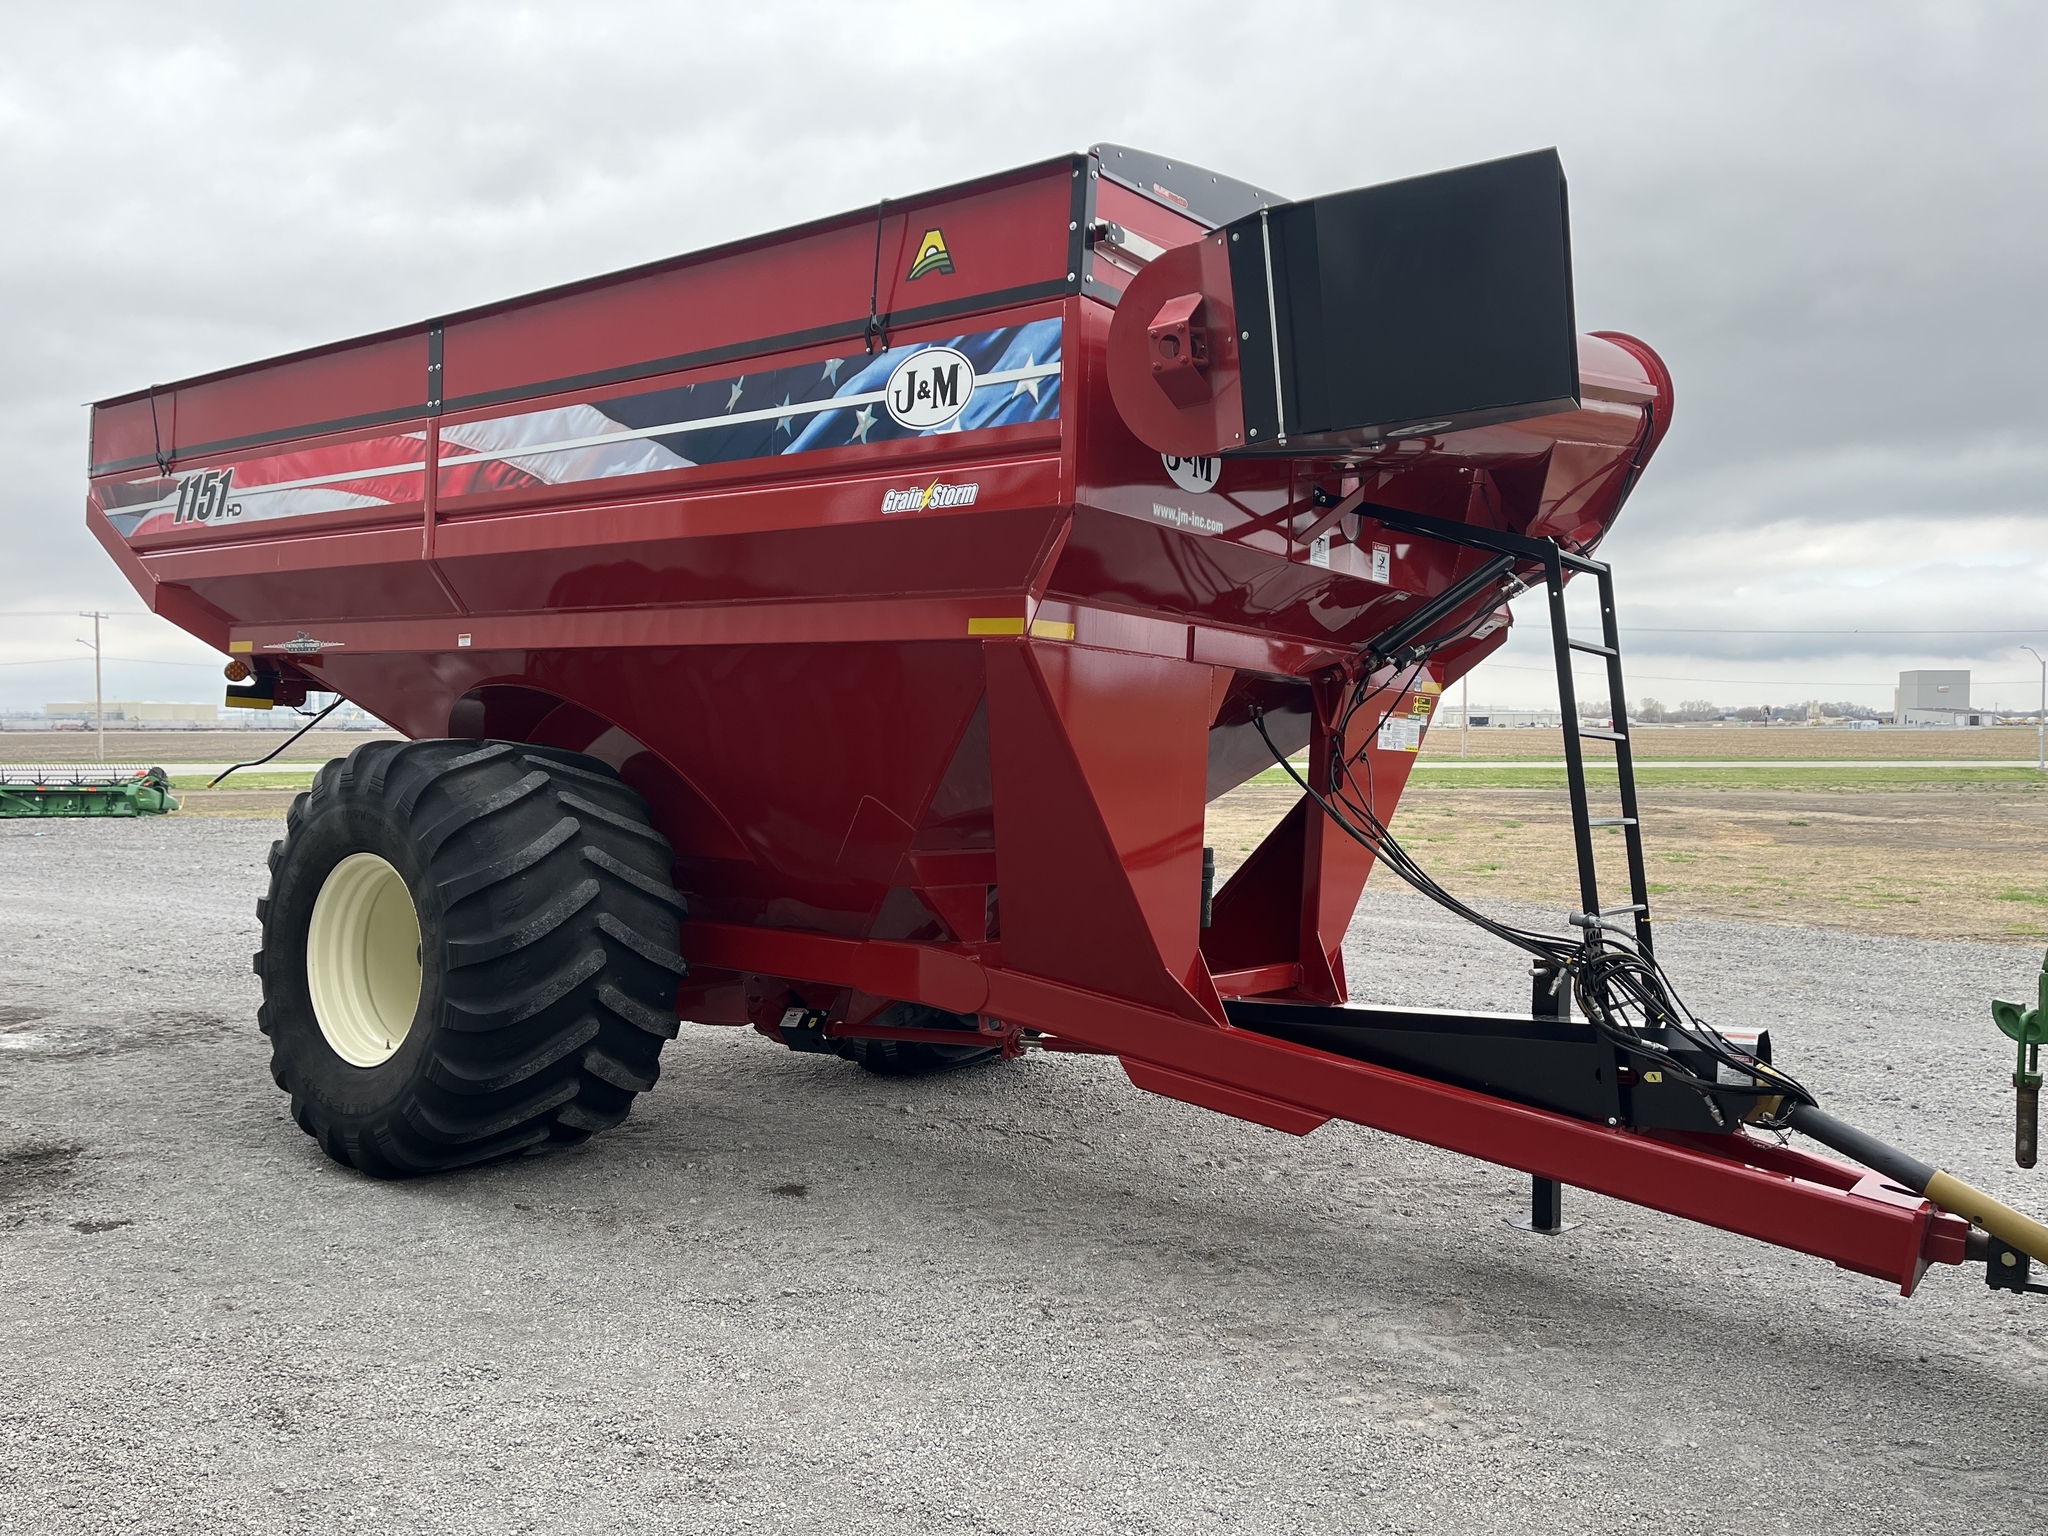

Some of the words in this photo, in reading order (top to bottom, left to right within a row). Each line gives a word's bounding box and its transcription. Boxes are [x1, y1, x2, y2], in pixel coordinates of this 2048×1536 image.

[894, 363, 960, 414] J&M
[174, 468, 234, 523] 1151
[227, 503, 242, 517] HD
[882, 488, 925, 513] Grain
[928, 484, 978, 508] Storm
[1152, 502, 1224, 535] www.jm-inc.com
